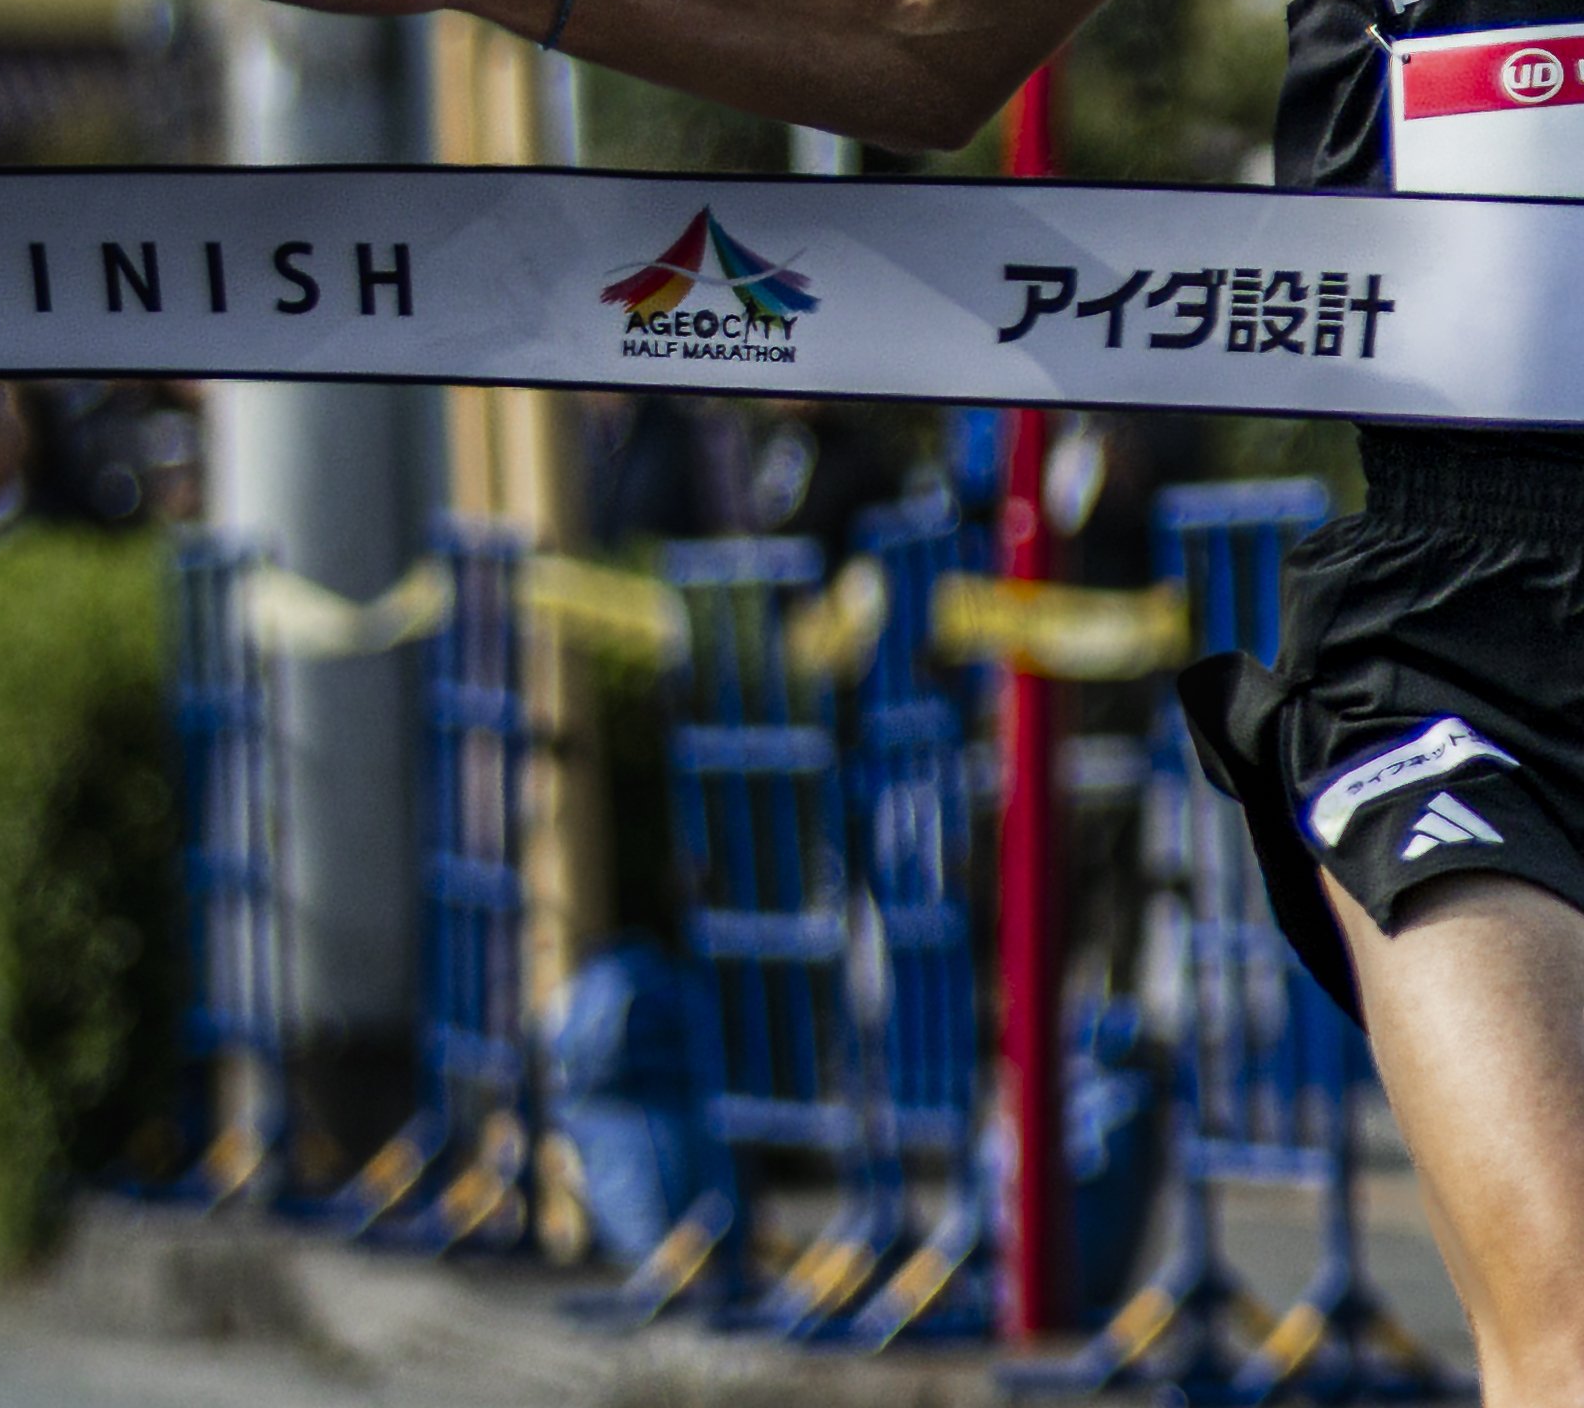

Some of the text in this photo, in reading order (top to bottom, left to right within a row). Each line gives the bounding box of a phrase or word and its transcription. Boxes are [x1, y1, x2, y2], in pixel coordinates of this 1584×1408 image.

[998, 264, 1396, 359] アイダ設計
[622, 339, 797, 364] HALF MARATHON
